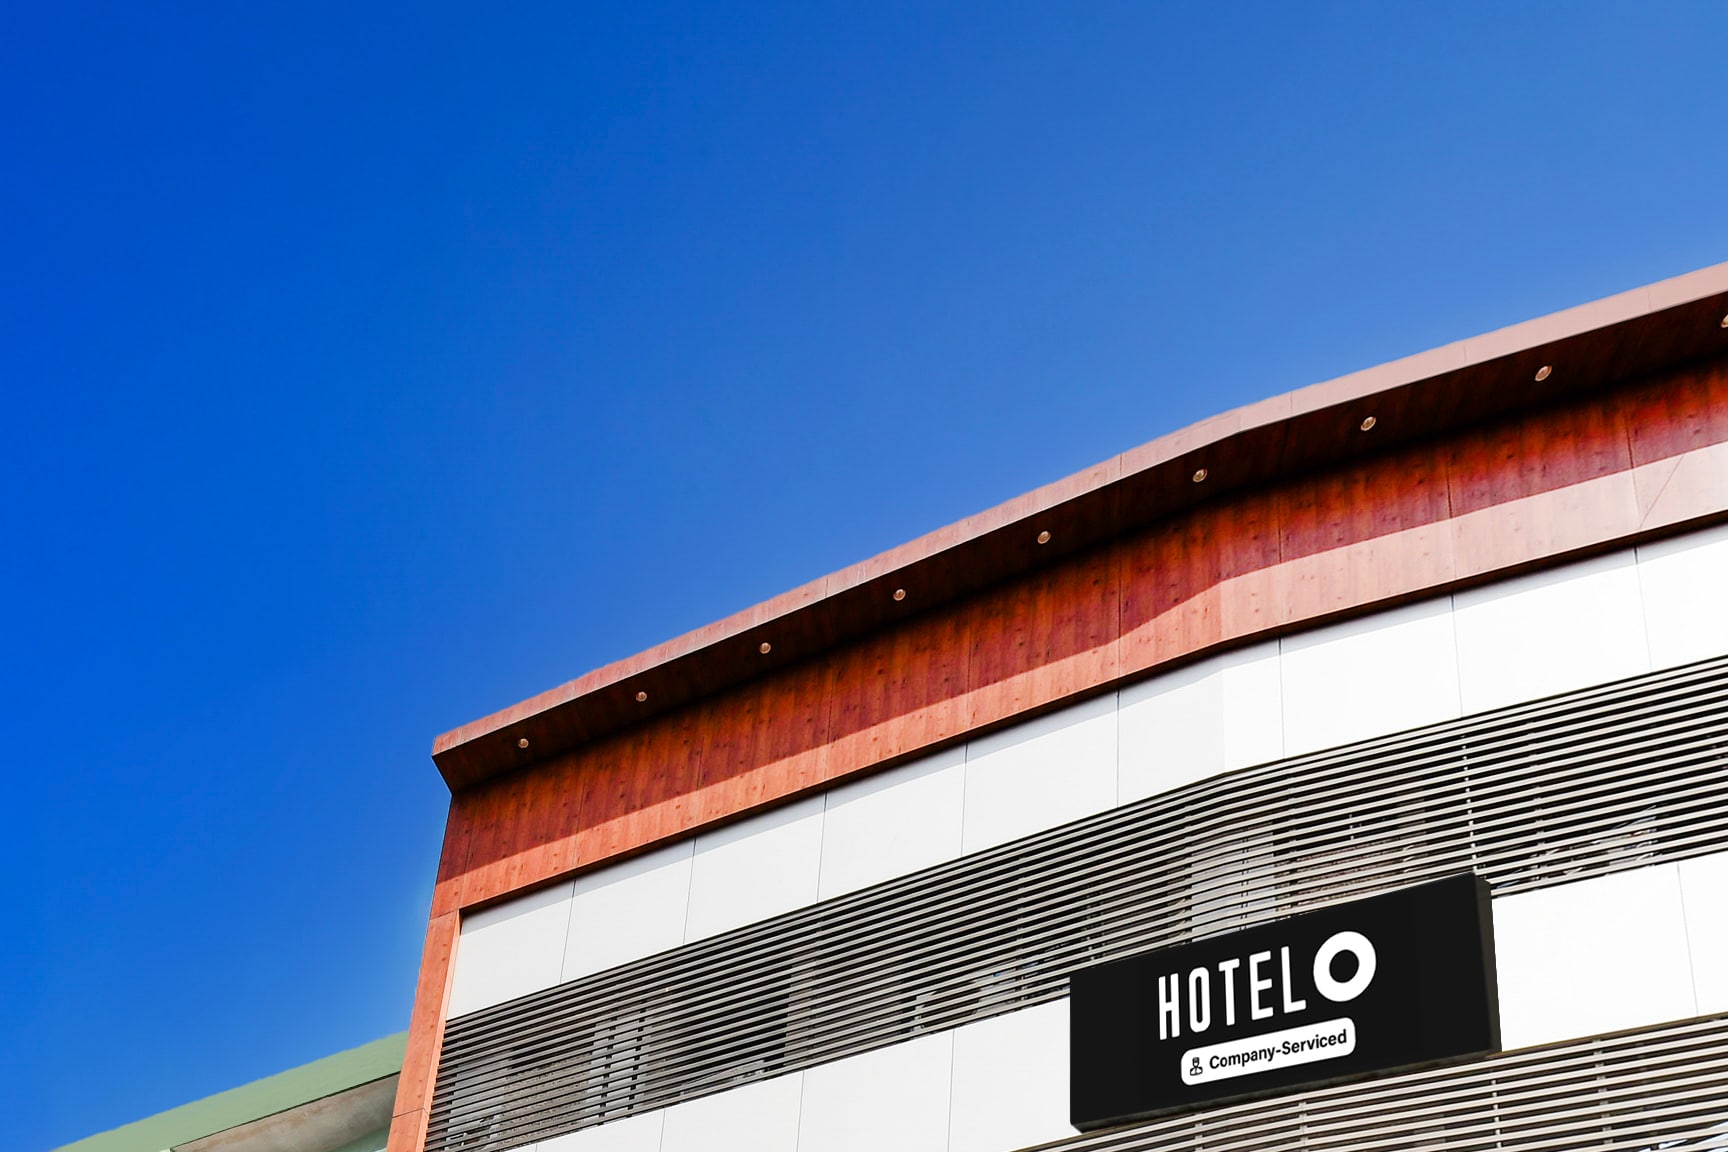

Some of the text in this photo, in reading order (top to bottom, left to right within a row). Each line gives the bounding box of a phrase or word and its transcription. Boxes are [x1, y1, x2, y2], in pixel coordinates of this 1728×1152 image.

[1158, 930, 1377, 1041] HOTEL O
[1208, 1028, 1348, 1071] Company-Serviced
